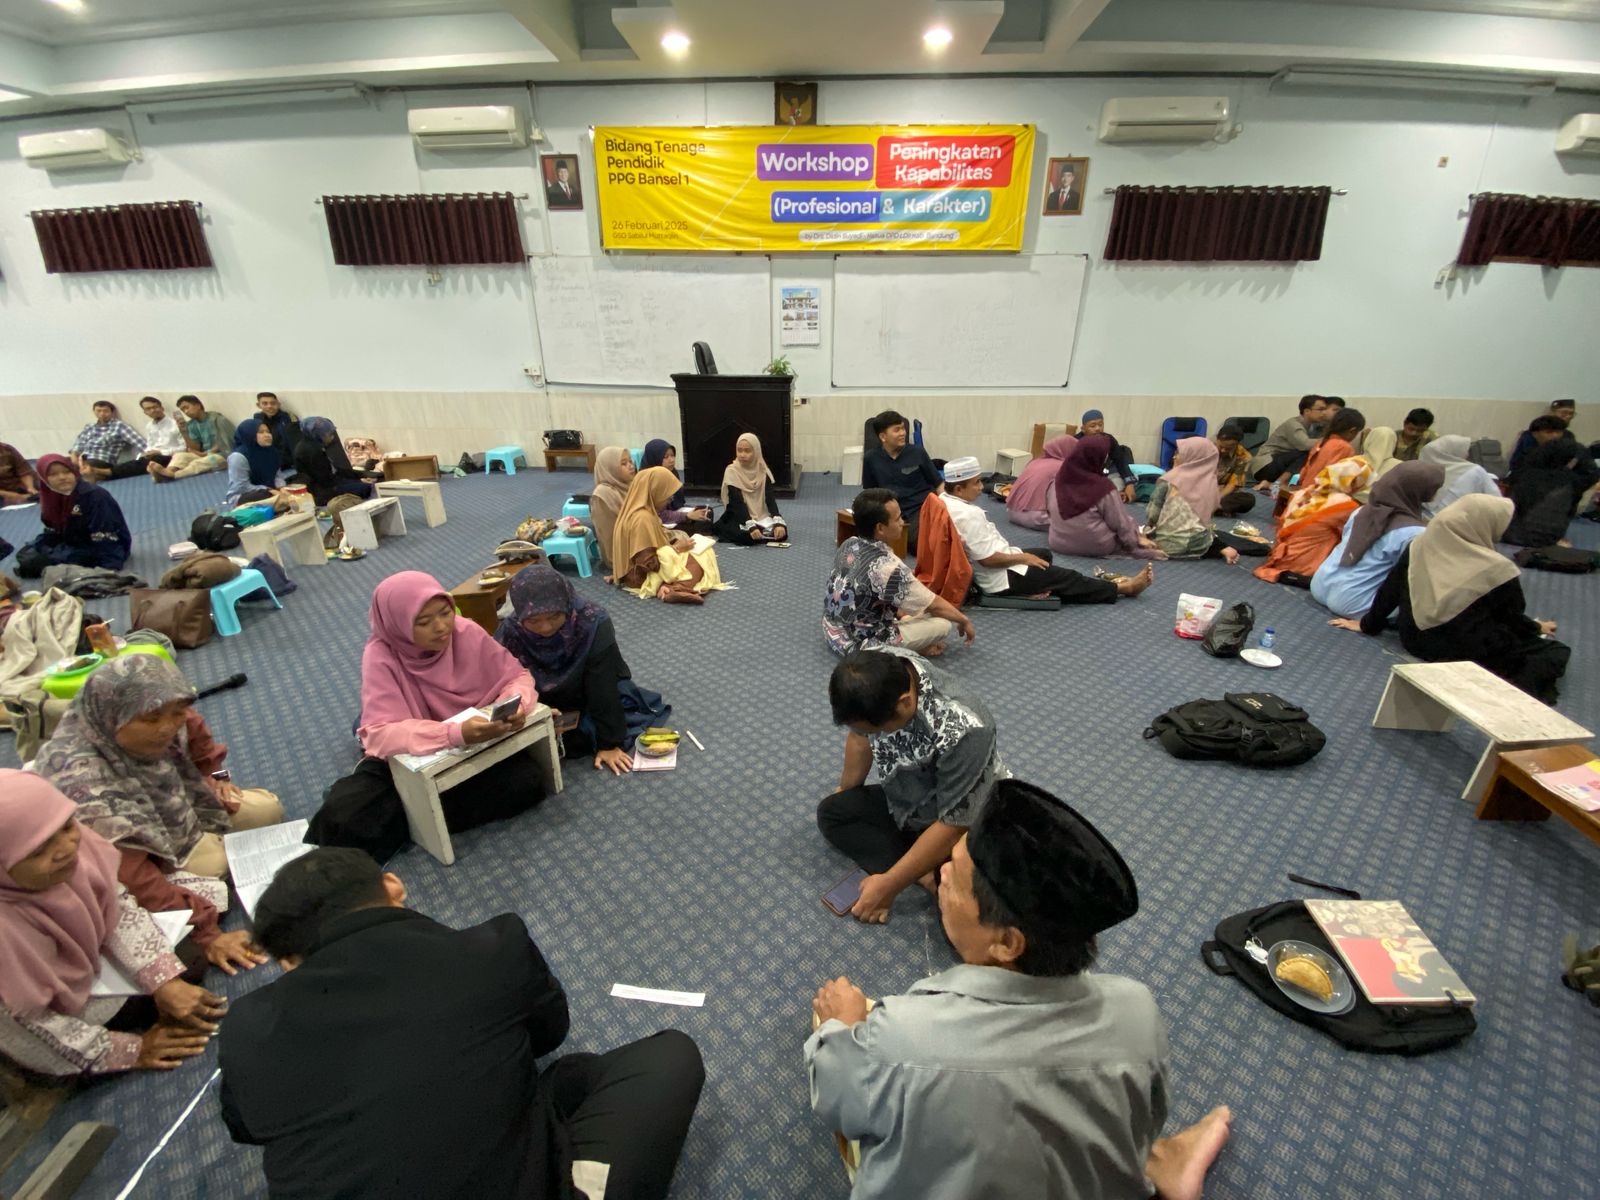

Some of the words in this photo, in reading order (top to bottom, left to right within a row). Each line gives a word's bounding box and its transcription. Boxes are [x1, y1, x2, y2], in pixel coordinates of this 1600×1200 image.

[605, 139, 652, 155] Bidang
[654, 141, 706, 156] Tenaga
[889, 142, 1002, 164] Peningkatan
[607, 156, 665, 168] Pendidik
[761, 151, 869, 177] Workshop
[608, 172, 636, 185] PPG
[638, 172, 682, 185] Bansel
[895, 163, 993, 184] Kapabilitas
[773, 197, 877, 217] (Profesional
[882, 198, 895, 214] &
[903, 196, 986, 217] Karakter)
[612, 220, 624, 230] 26
[625, 220, 664, 230] Februari
[665, 220, 689, 231] 2025
